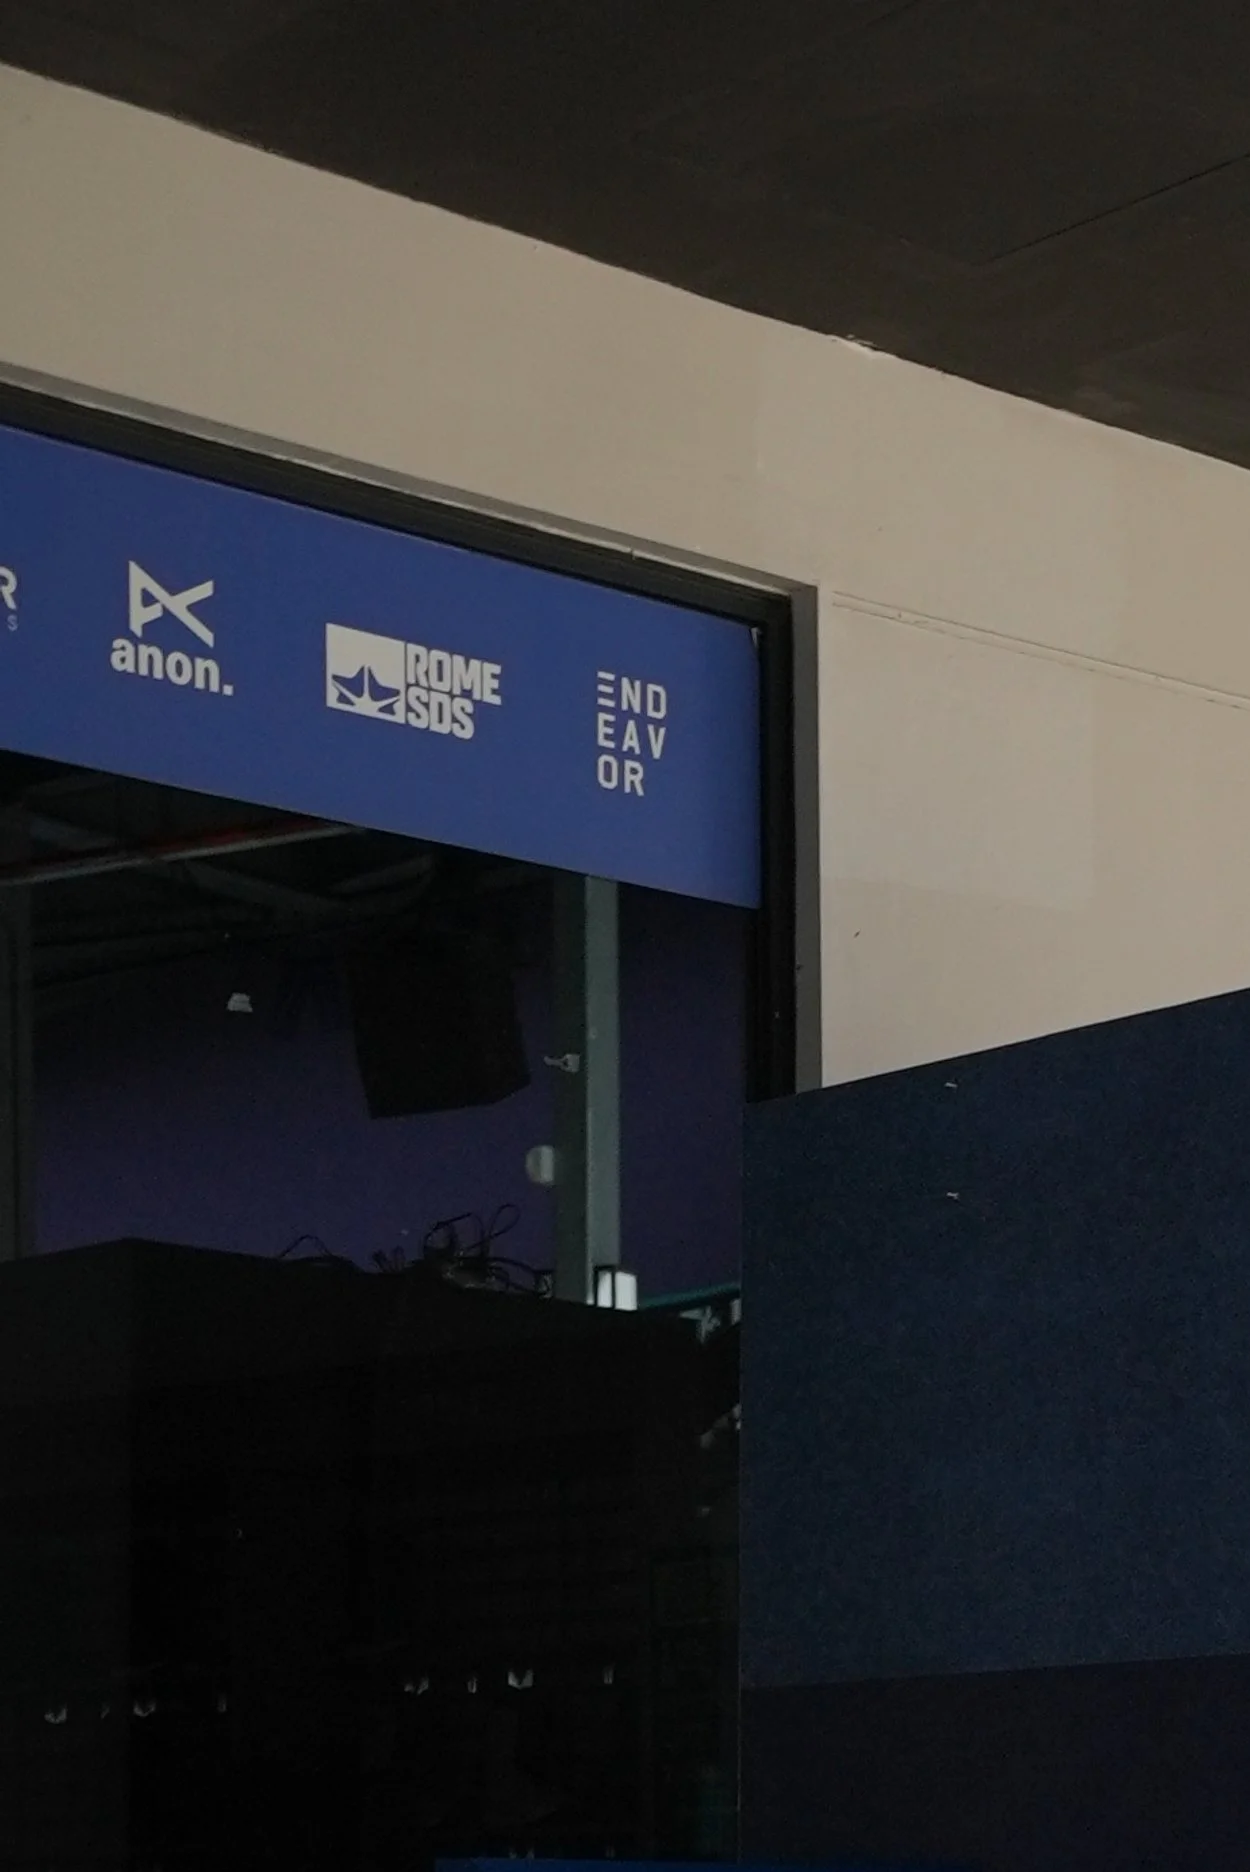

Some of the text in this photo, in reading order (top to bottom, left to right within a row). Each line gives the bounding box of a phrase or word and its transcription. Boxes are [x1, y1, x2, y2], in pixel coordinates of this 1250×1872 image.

[111, 638, 234, 696] anon.
[407, 643, 502, 705] ROME
[407, 686, 475, 739] SDS
[598, 671, 667, 720] END
[598, 712, 667, 760] EAV
[598, 755, 644, 796] OR
